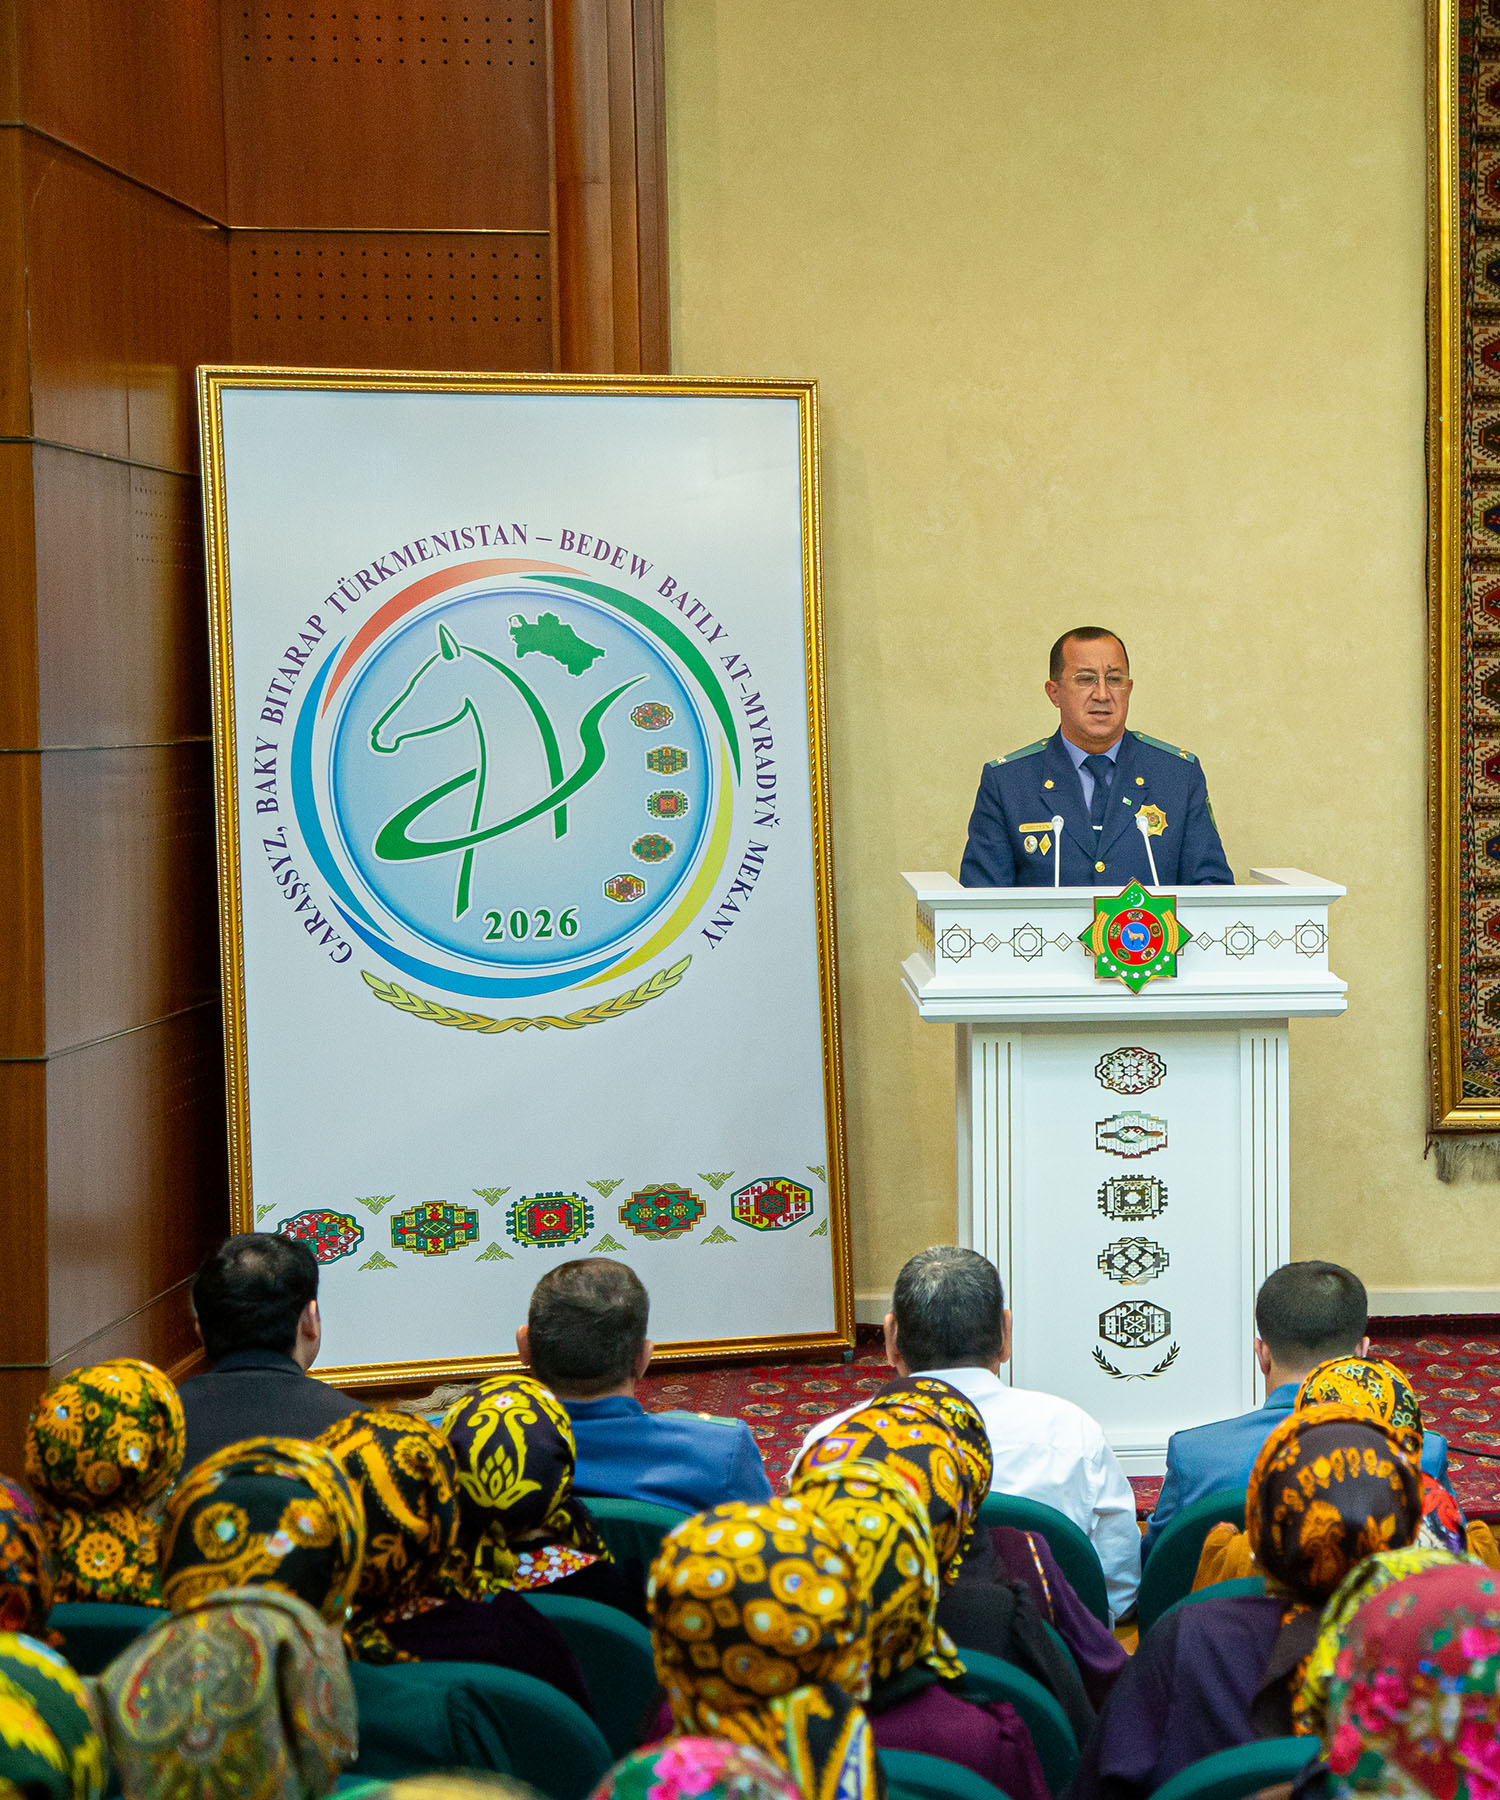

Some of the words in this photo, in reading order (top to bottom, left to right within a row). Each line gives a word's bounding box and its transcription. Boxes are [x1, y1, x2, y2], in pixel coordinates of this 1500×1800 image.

[323, 523, 528, 615] TÜRKMENISTAN
[559, 528, 655, 580] BEDEW
[656, 574, 729, 645] BATLY
[260, 615, 328, 726] BITARAP
[254, 735, 279, 815] BAKY
[263, 826, 353, 964] GARAŞSYZ,
[485, 909, 578, 939] 2026
[700, 839, 770, 951] MEKANY
